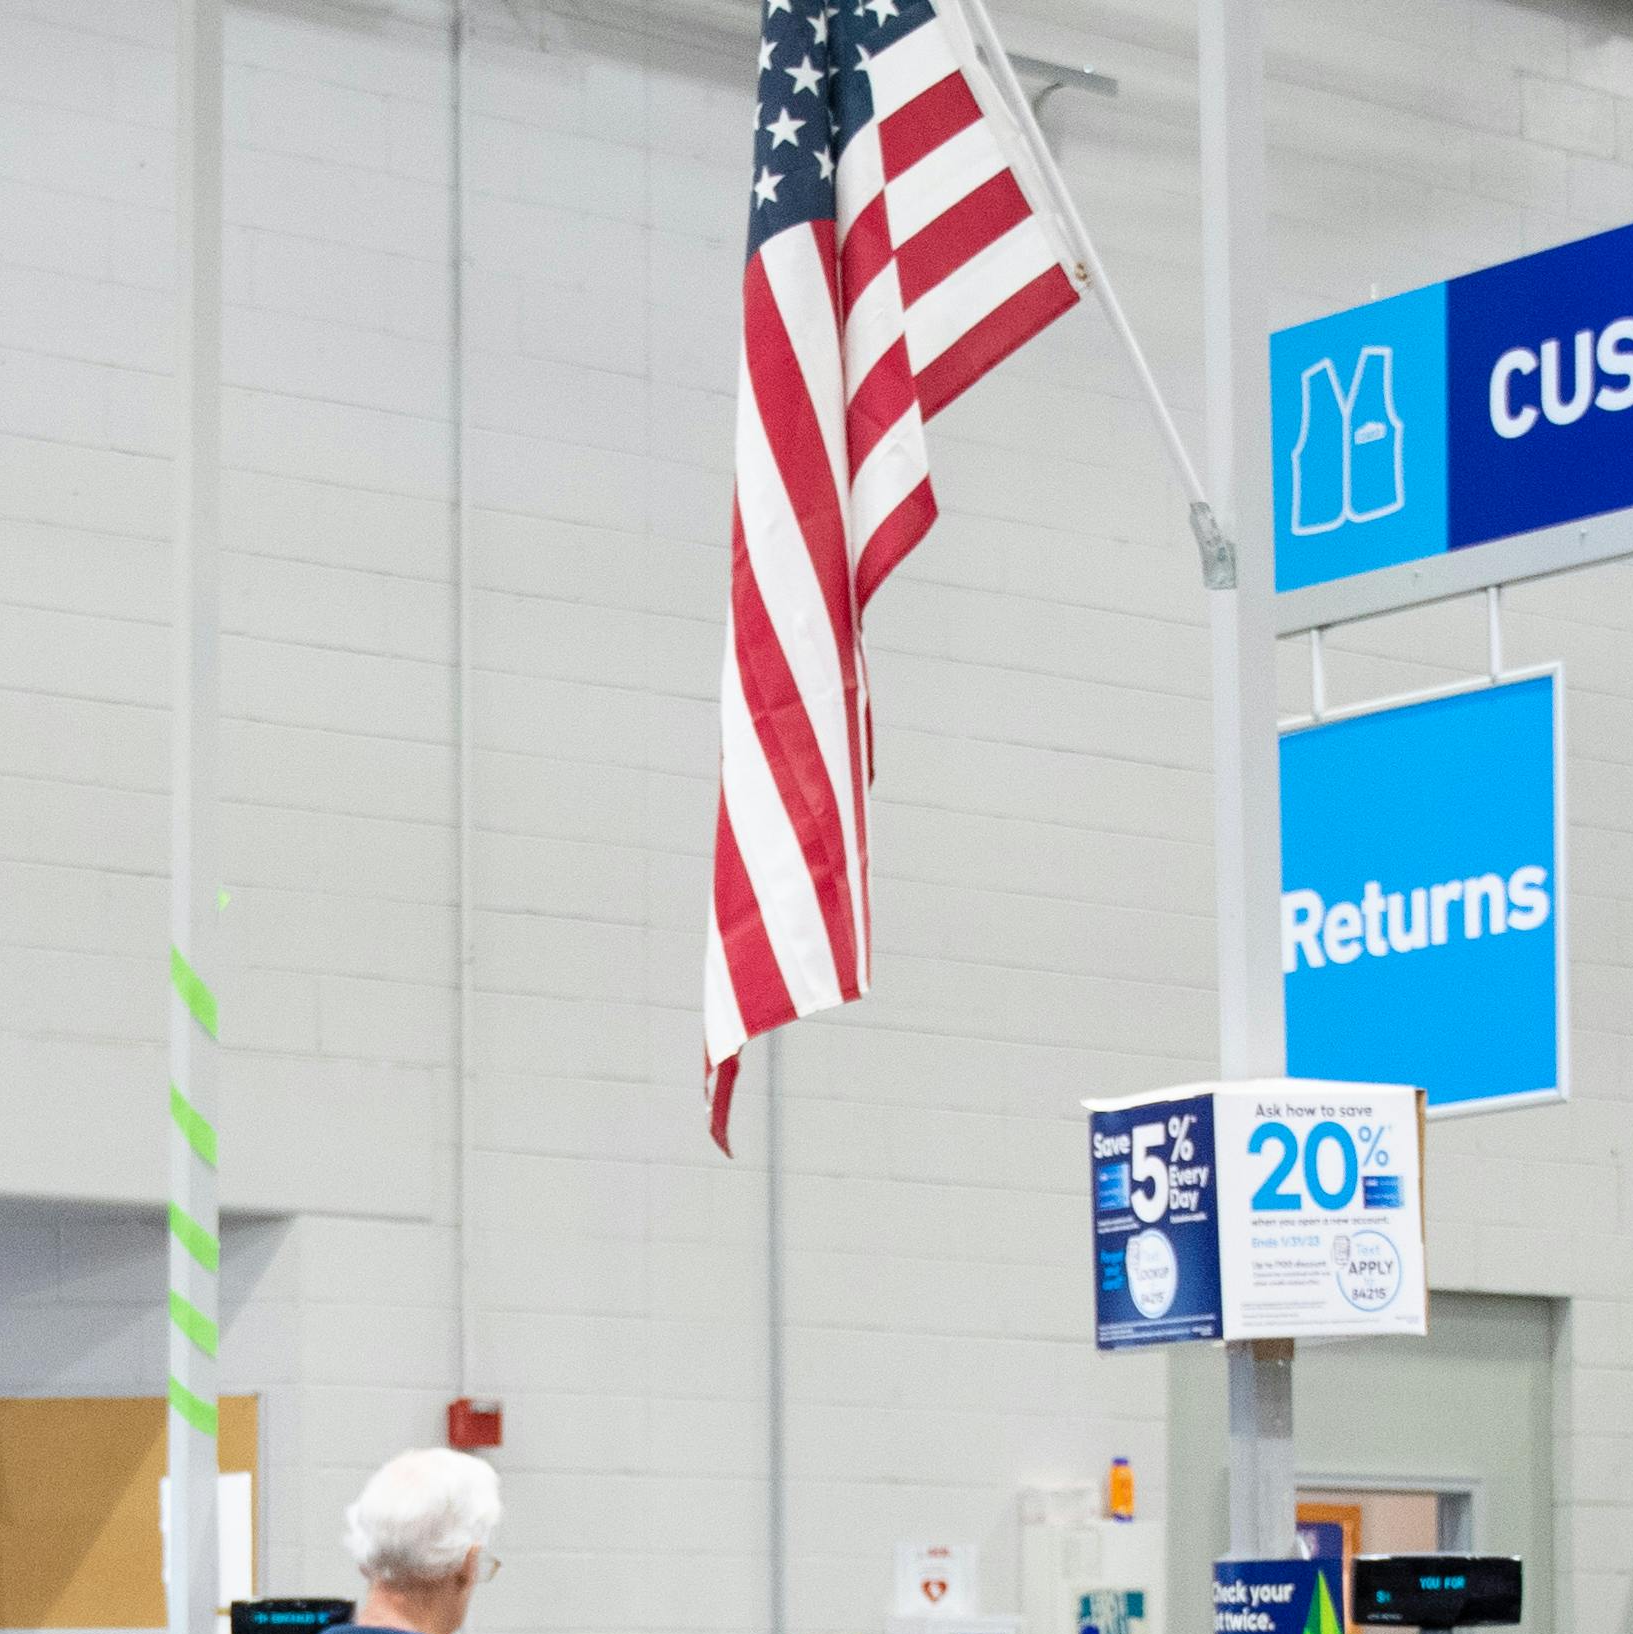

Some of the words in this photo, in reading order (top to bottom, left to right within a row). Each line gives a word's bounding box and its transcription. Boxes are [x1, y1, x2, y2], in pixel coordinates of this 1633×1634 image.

[1281, 865, 1550, 974] Returns
[1255, 1104, 1281, 1117] Ask
[1286, 1103, 1315, 1117] how
[1321, 1105, 1334, 1117] to
[1340, 1106, 1372, 1117] save
[1093, 1132, 1131, 1159] Save
[1168, 1164, 1209, 1188] Every
[1169, 1188, 1199, 1211] Day
[1348, 1261, 1393, 1276] APPLY
[1419, 1575, 1441, 1590] YOU
[1250, 1582, 1296, 1607] your
